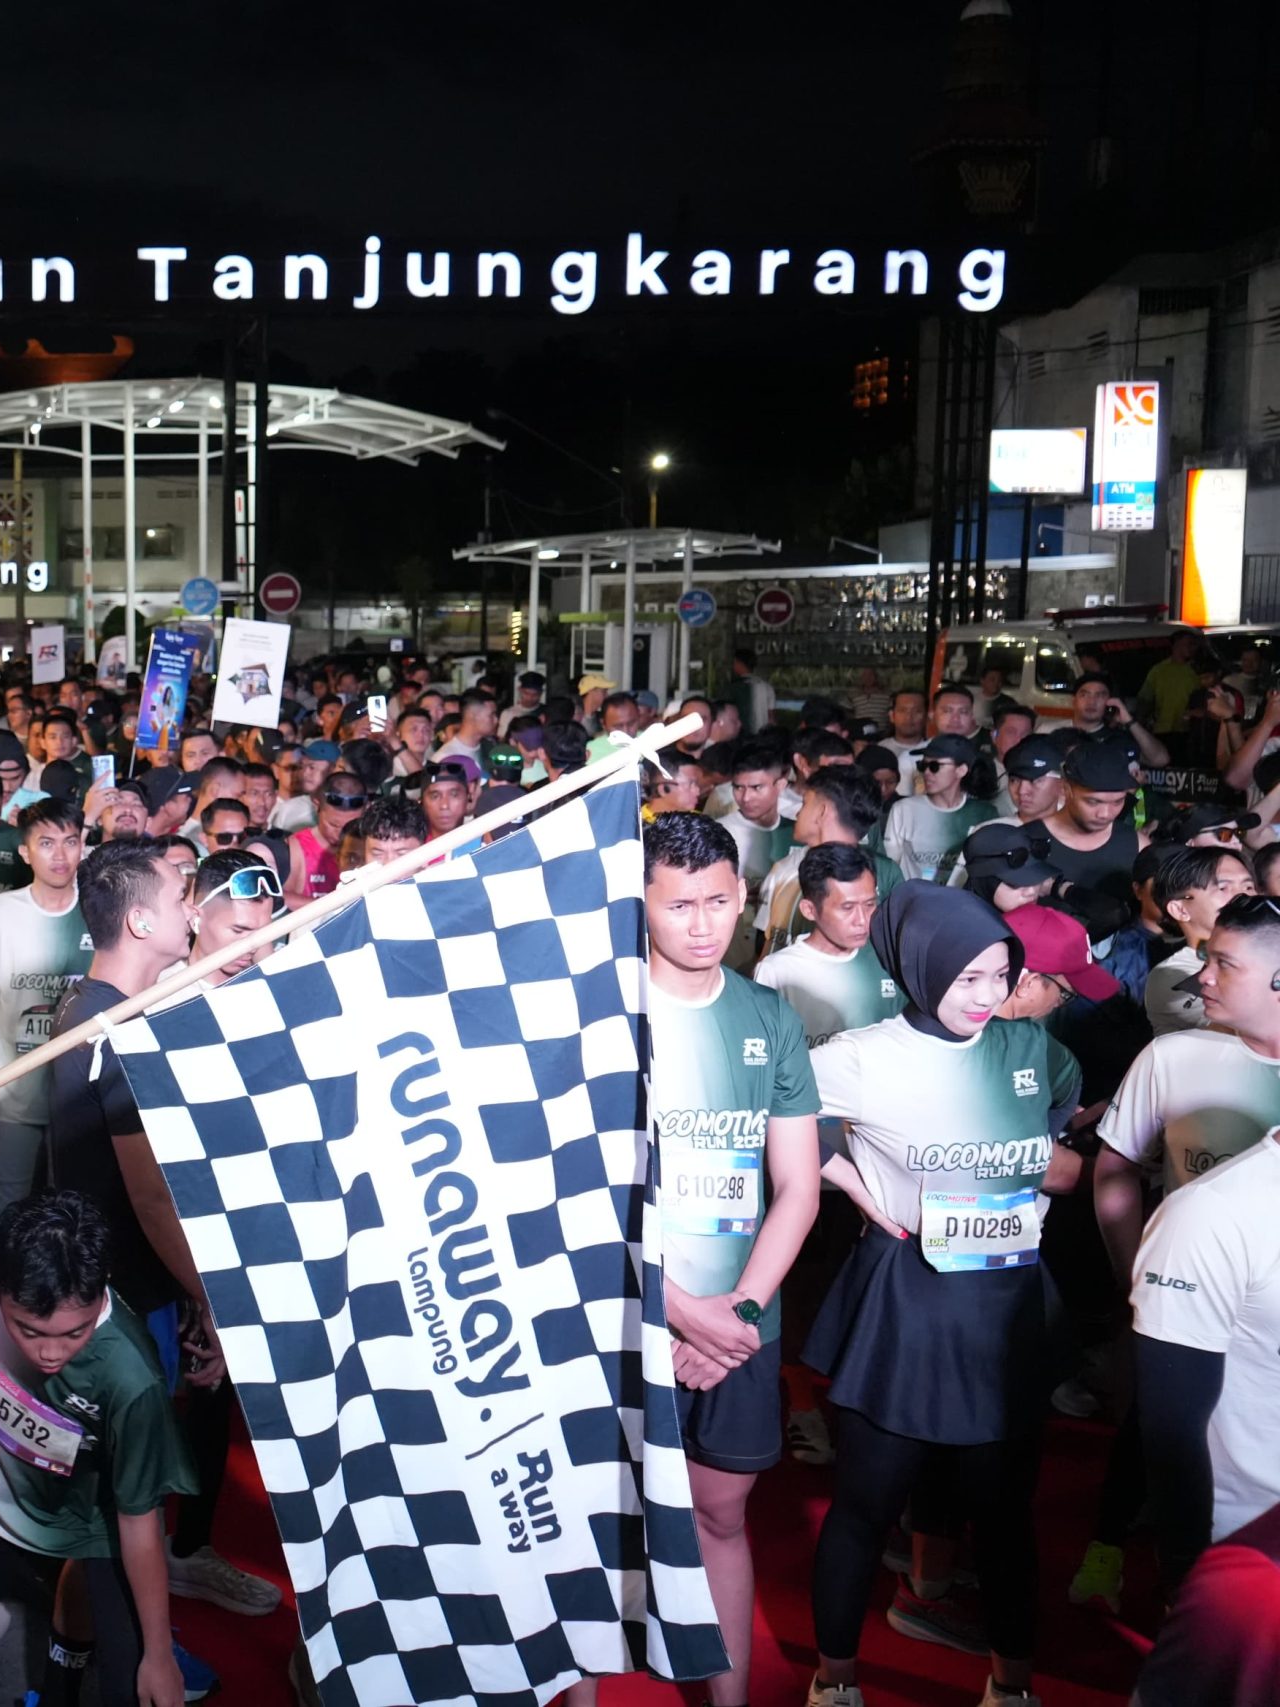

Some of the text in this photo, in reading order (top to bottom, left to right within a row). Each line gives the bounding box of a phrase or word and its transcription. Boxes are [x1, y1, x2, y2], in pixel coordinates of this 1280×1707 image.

[137, 233, 1008, 315] Tanjungkarang
[1111, 483, 1136, 494] ATM
[11, 973, 84, 991] LOCOMOT
[26, 1018, 53, 1036] A10
[692, 1134, 766, 1150] RUN 202
[907, 1133, 1053, 1172] LOCOMOTIV
[976, 1159, 1051, 1180] RUN 202
[677, 1174, 745, 1200] C10298
[926, 1193, 978, 1203] LOCOMOTIVE
[377, 1031, 531, 1422] runaway.
[945, 1215, 1023, 1239] D10299
[517, 1448, 563, 1543] Run
[491, 1467, 532, 1554] a way
[48, 1636, 91, 1669] VANS
